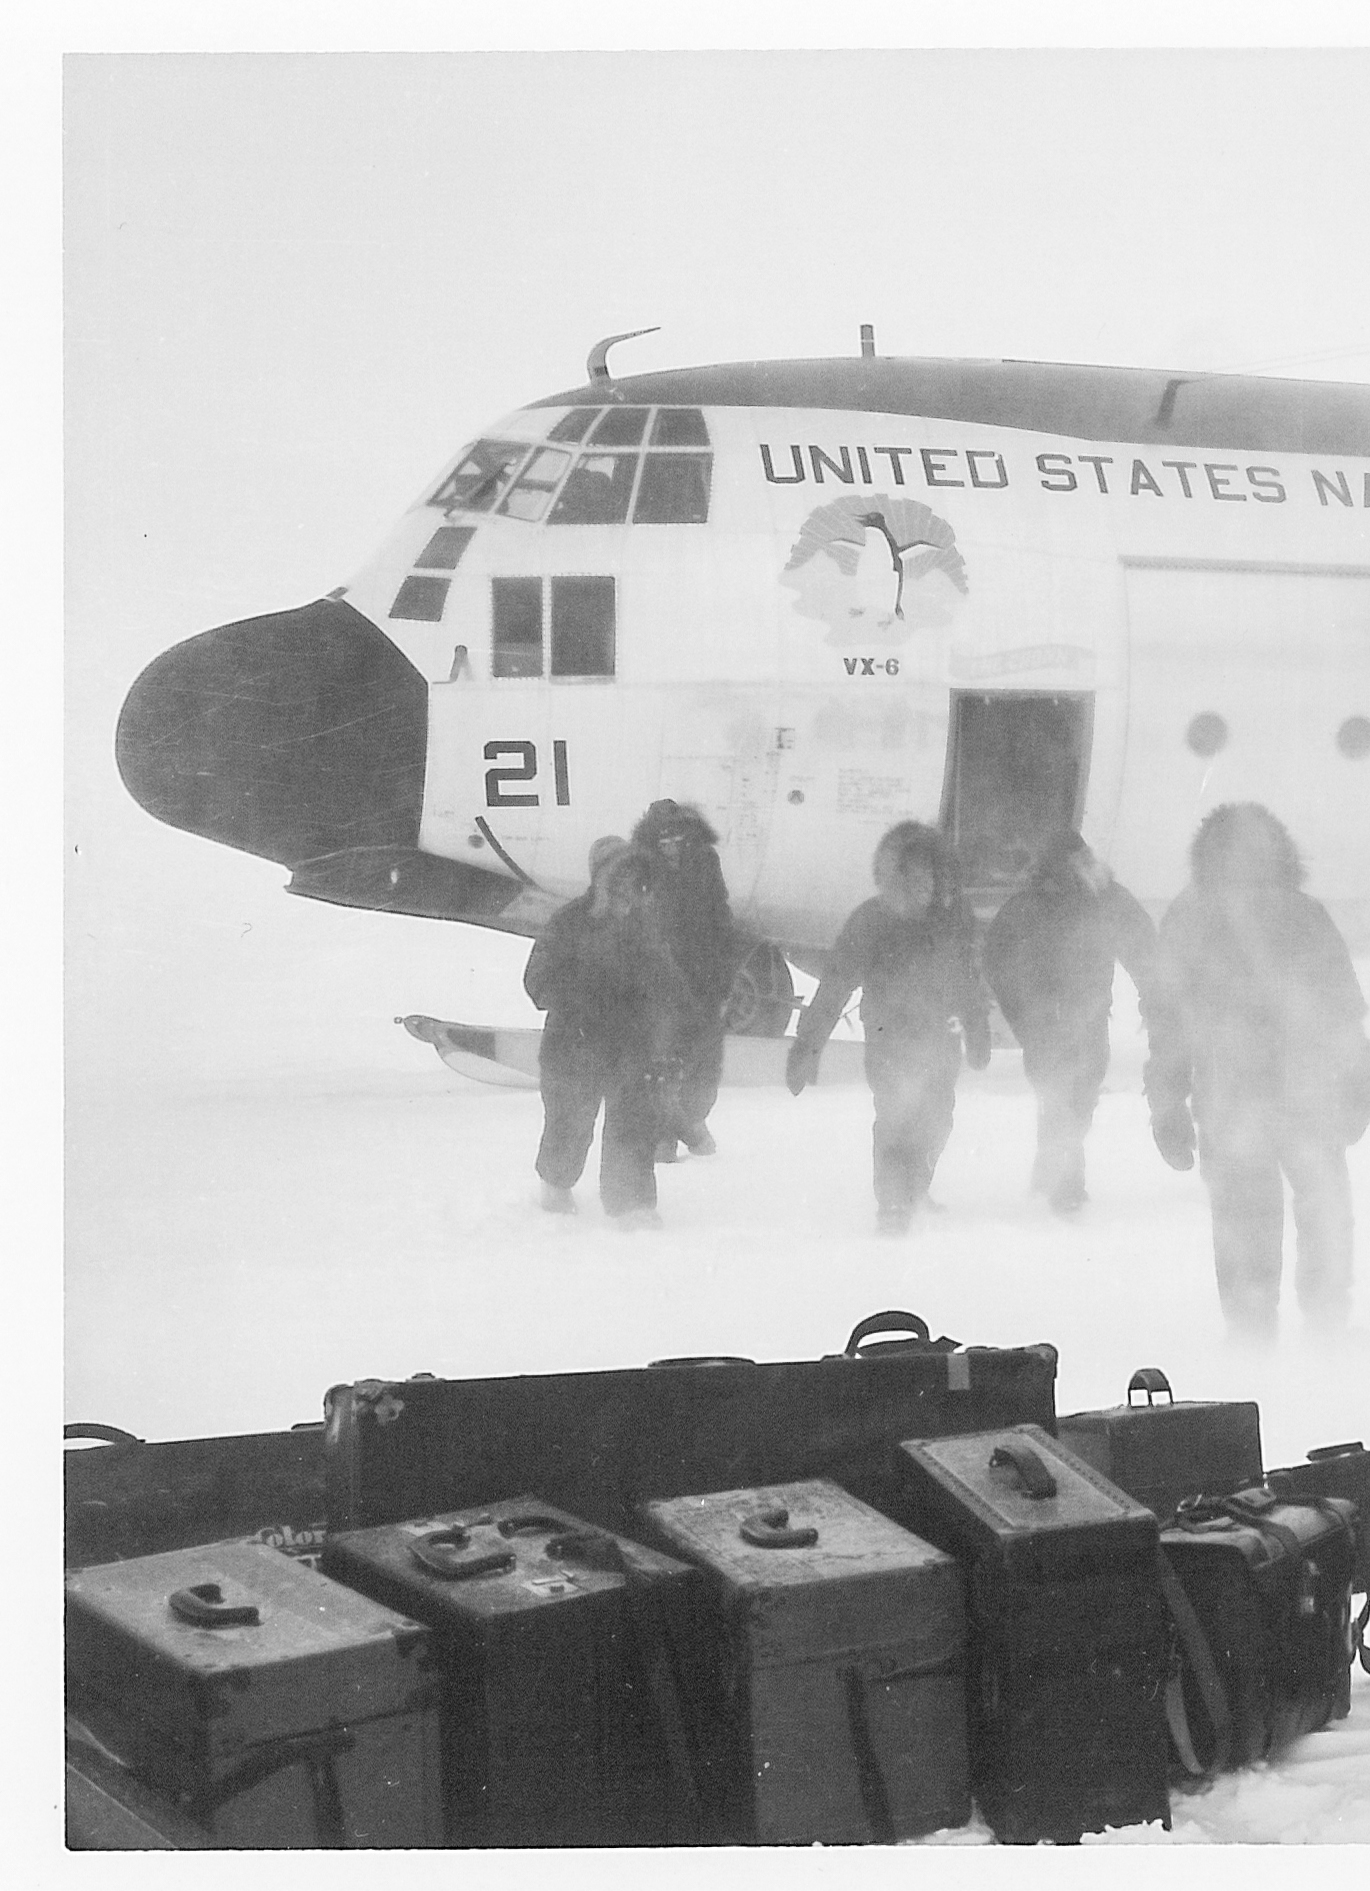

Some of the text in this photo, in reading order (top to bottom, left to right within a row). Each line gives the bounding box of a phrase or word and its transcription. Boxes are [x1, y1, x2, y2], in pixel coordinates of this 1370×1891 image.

[759, 443, 1010, 489] UNITED
[1034, 453, 1287, 505] STATES
[842, 657, 900, 677] VX-6
[482, 739, 571, 807] 21
